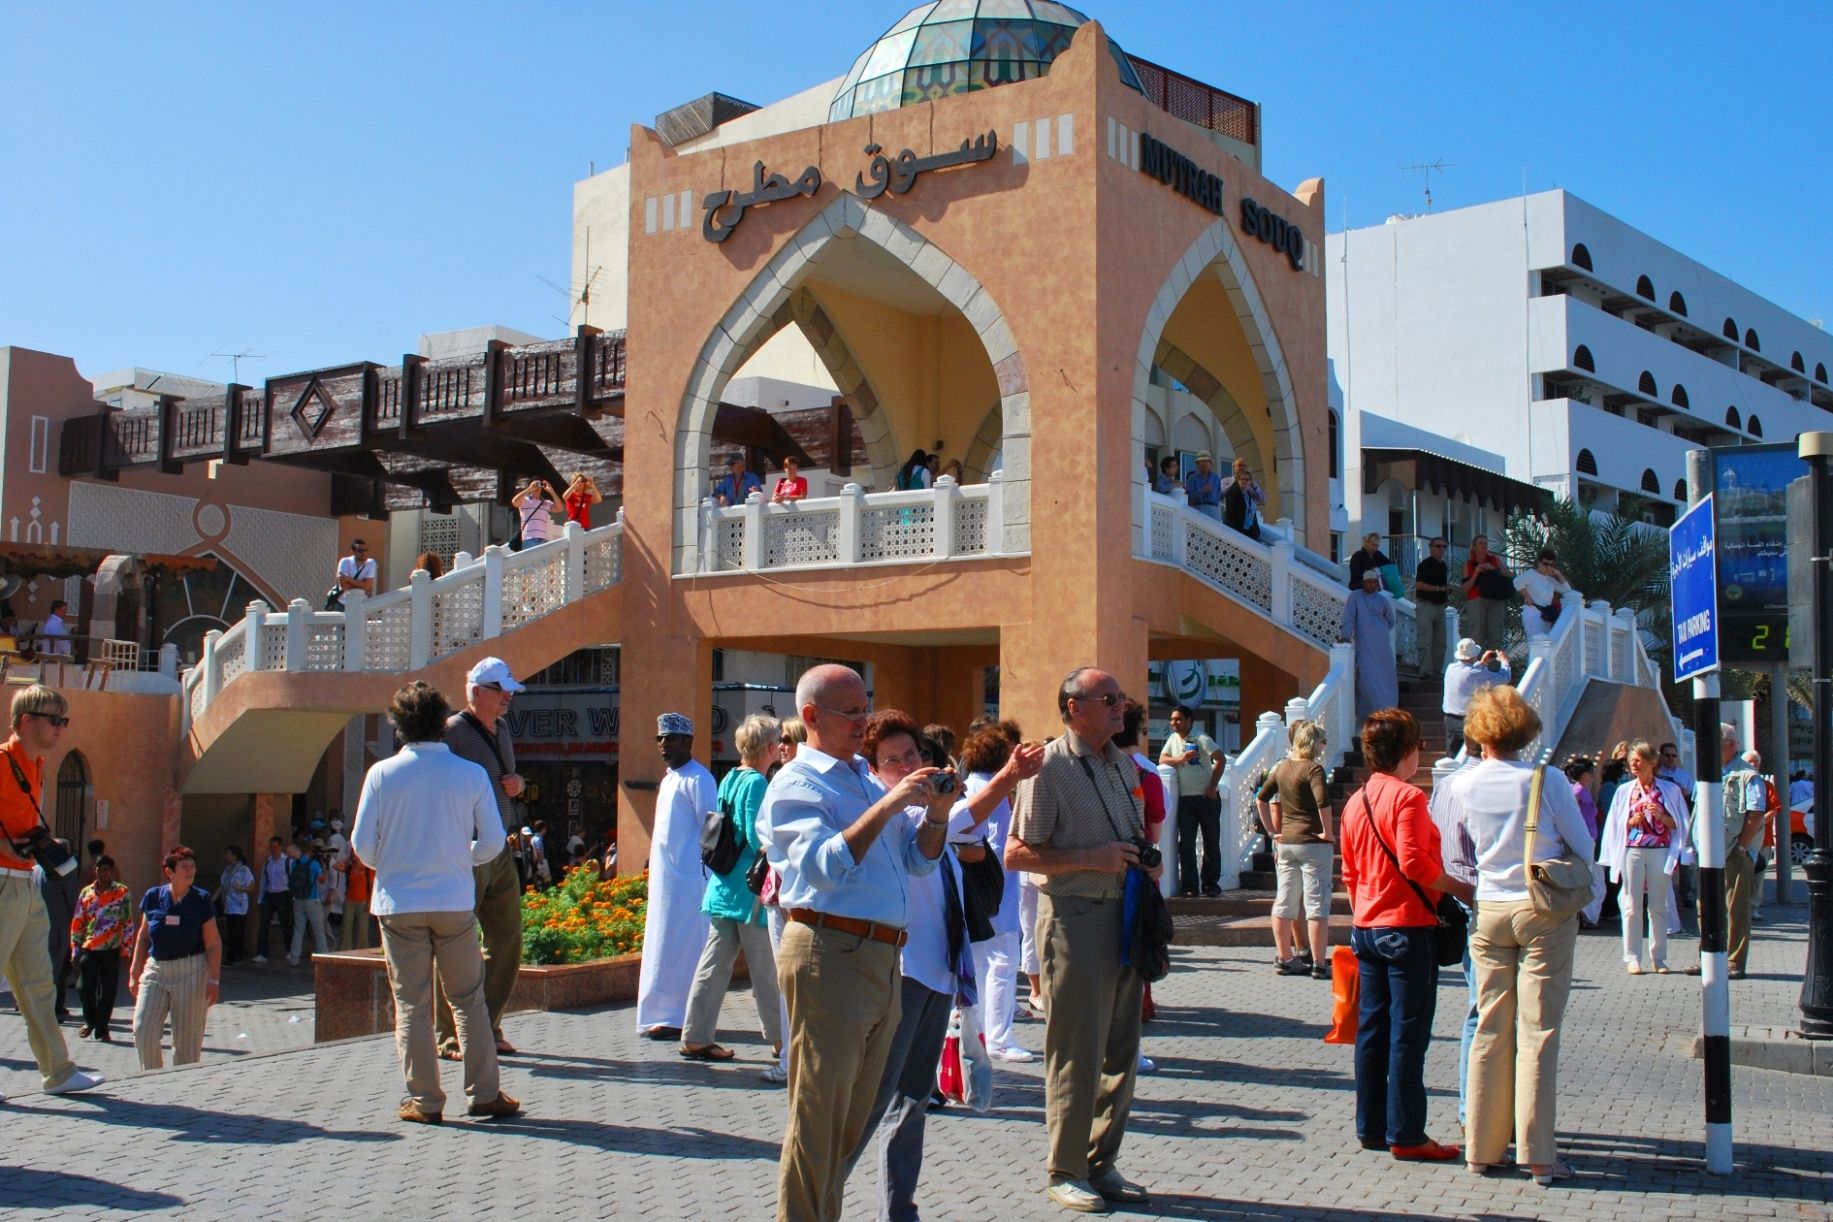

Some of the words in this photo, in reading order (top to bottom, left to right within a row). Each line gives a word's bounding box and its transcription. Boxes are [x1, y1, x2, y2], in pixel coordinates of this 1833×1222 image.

[702, 160, 821, 242] مطرح
[856, 129, 997, 199] سوق
[1141, 133, 1223, 216] MUTRAH
[1241, 198, 1303, 271] SOUQ
[1677, 621, 1688, 645] TAXI
[1687, 609, 1711, 640] PARKING
